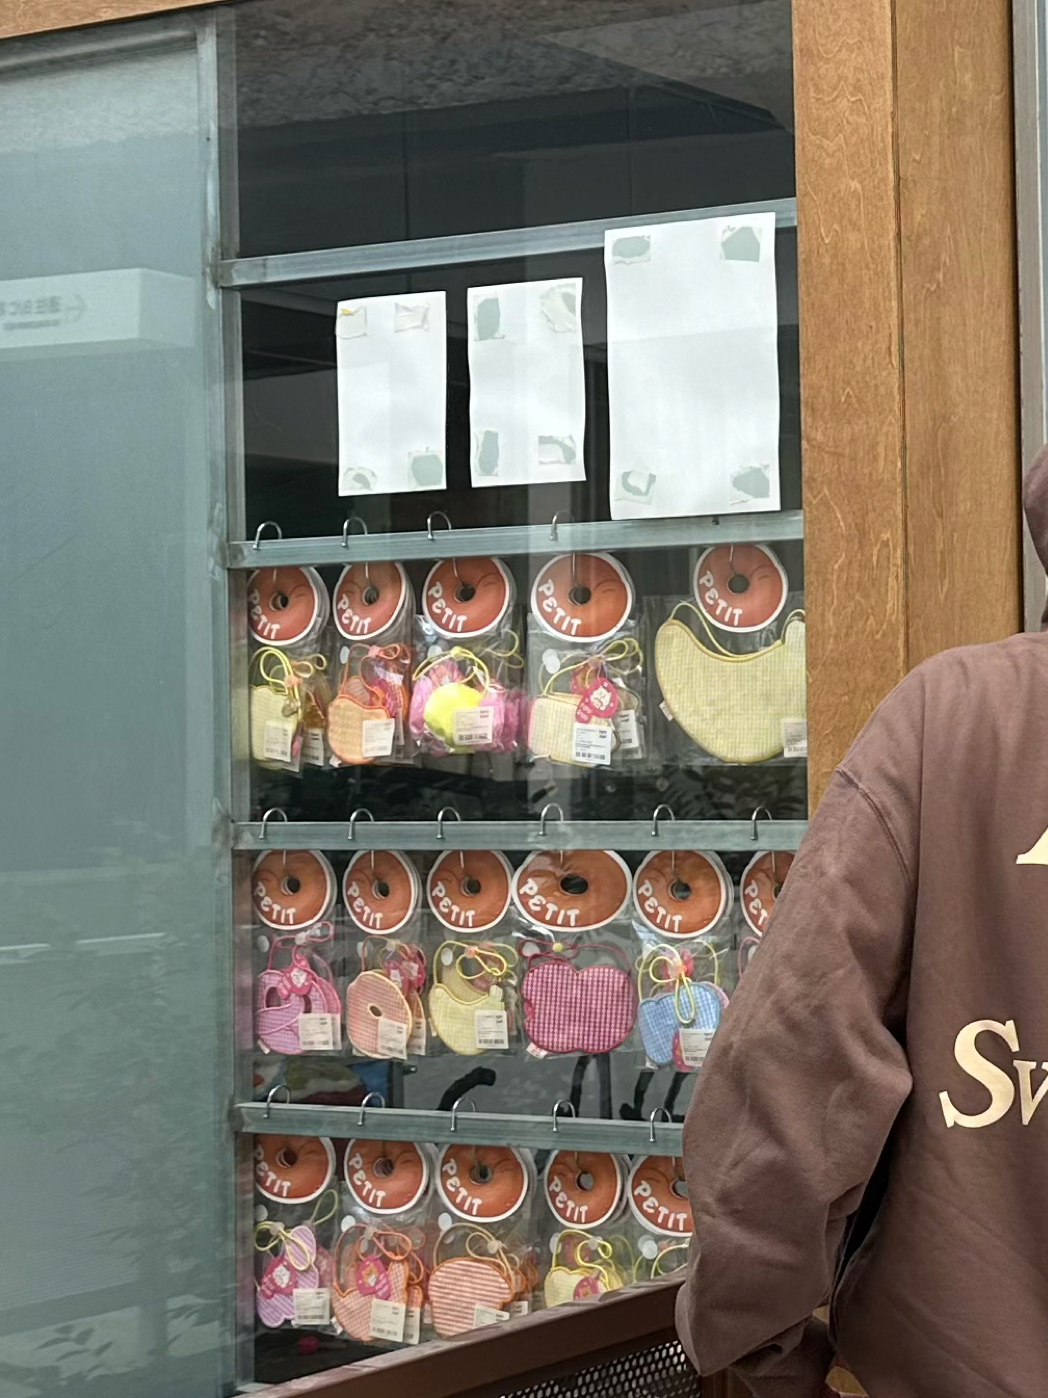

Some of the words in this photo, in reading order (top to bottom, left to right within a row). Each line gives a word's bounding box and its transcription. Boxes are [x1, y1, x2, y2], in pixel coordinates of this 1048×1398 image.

[338, 594, 371, 634] PETIT
[428, 581, 467, 632] PETIT
[538, 579, 582, 635] PETIT
[699, 570, 743, 627] PETIT
[254, 881, 296, 925] PETIT
[347, 881, 384, 929] PETIT
[432, 881, 475, 927] PETIT
[519, 878, 580, 926] PETIT
[638, 879, 682, 932] PETIT
[745, 880, 768, 926] PET
[349, 1153, 386, 1207] PETIT
[442, 1158, 482, 1215] PETIT
[549, 1176, 589, 1223] PETIT
[634, 1180, 688, 1231] PETIT
